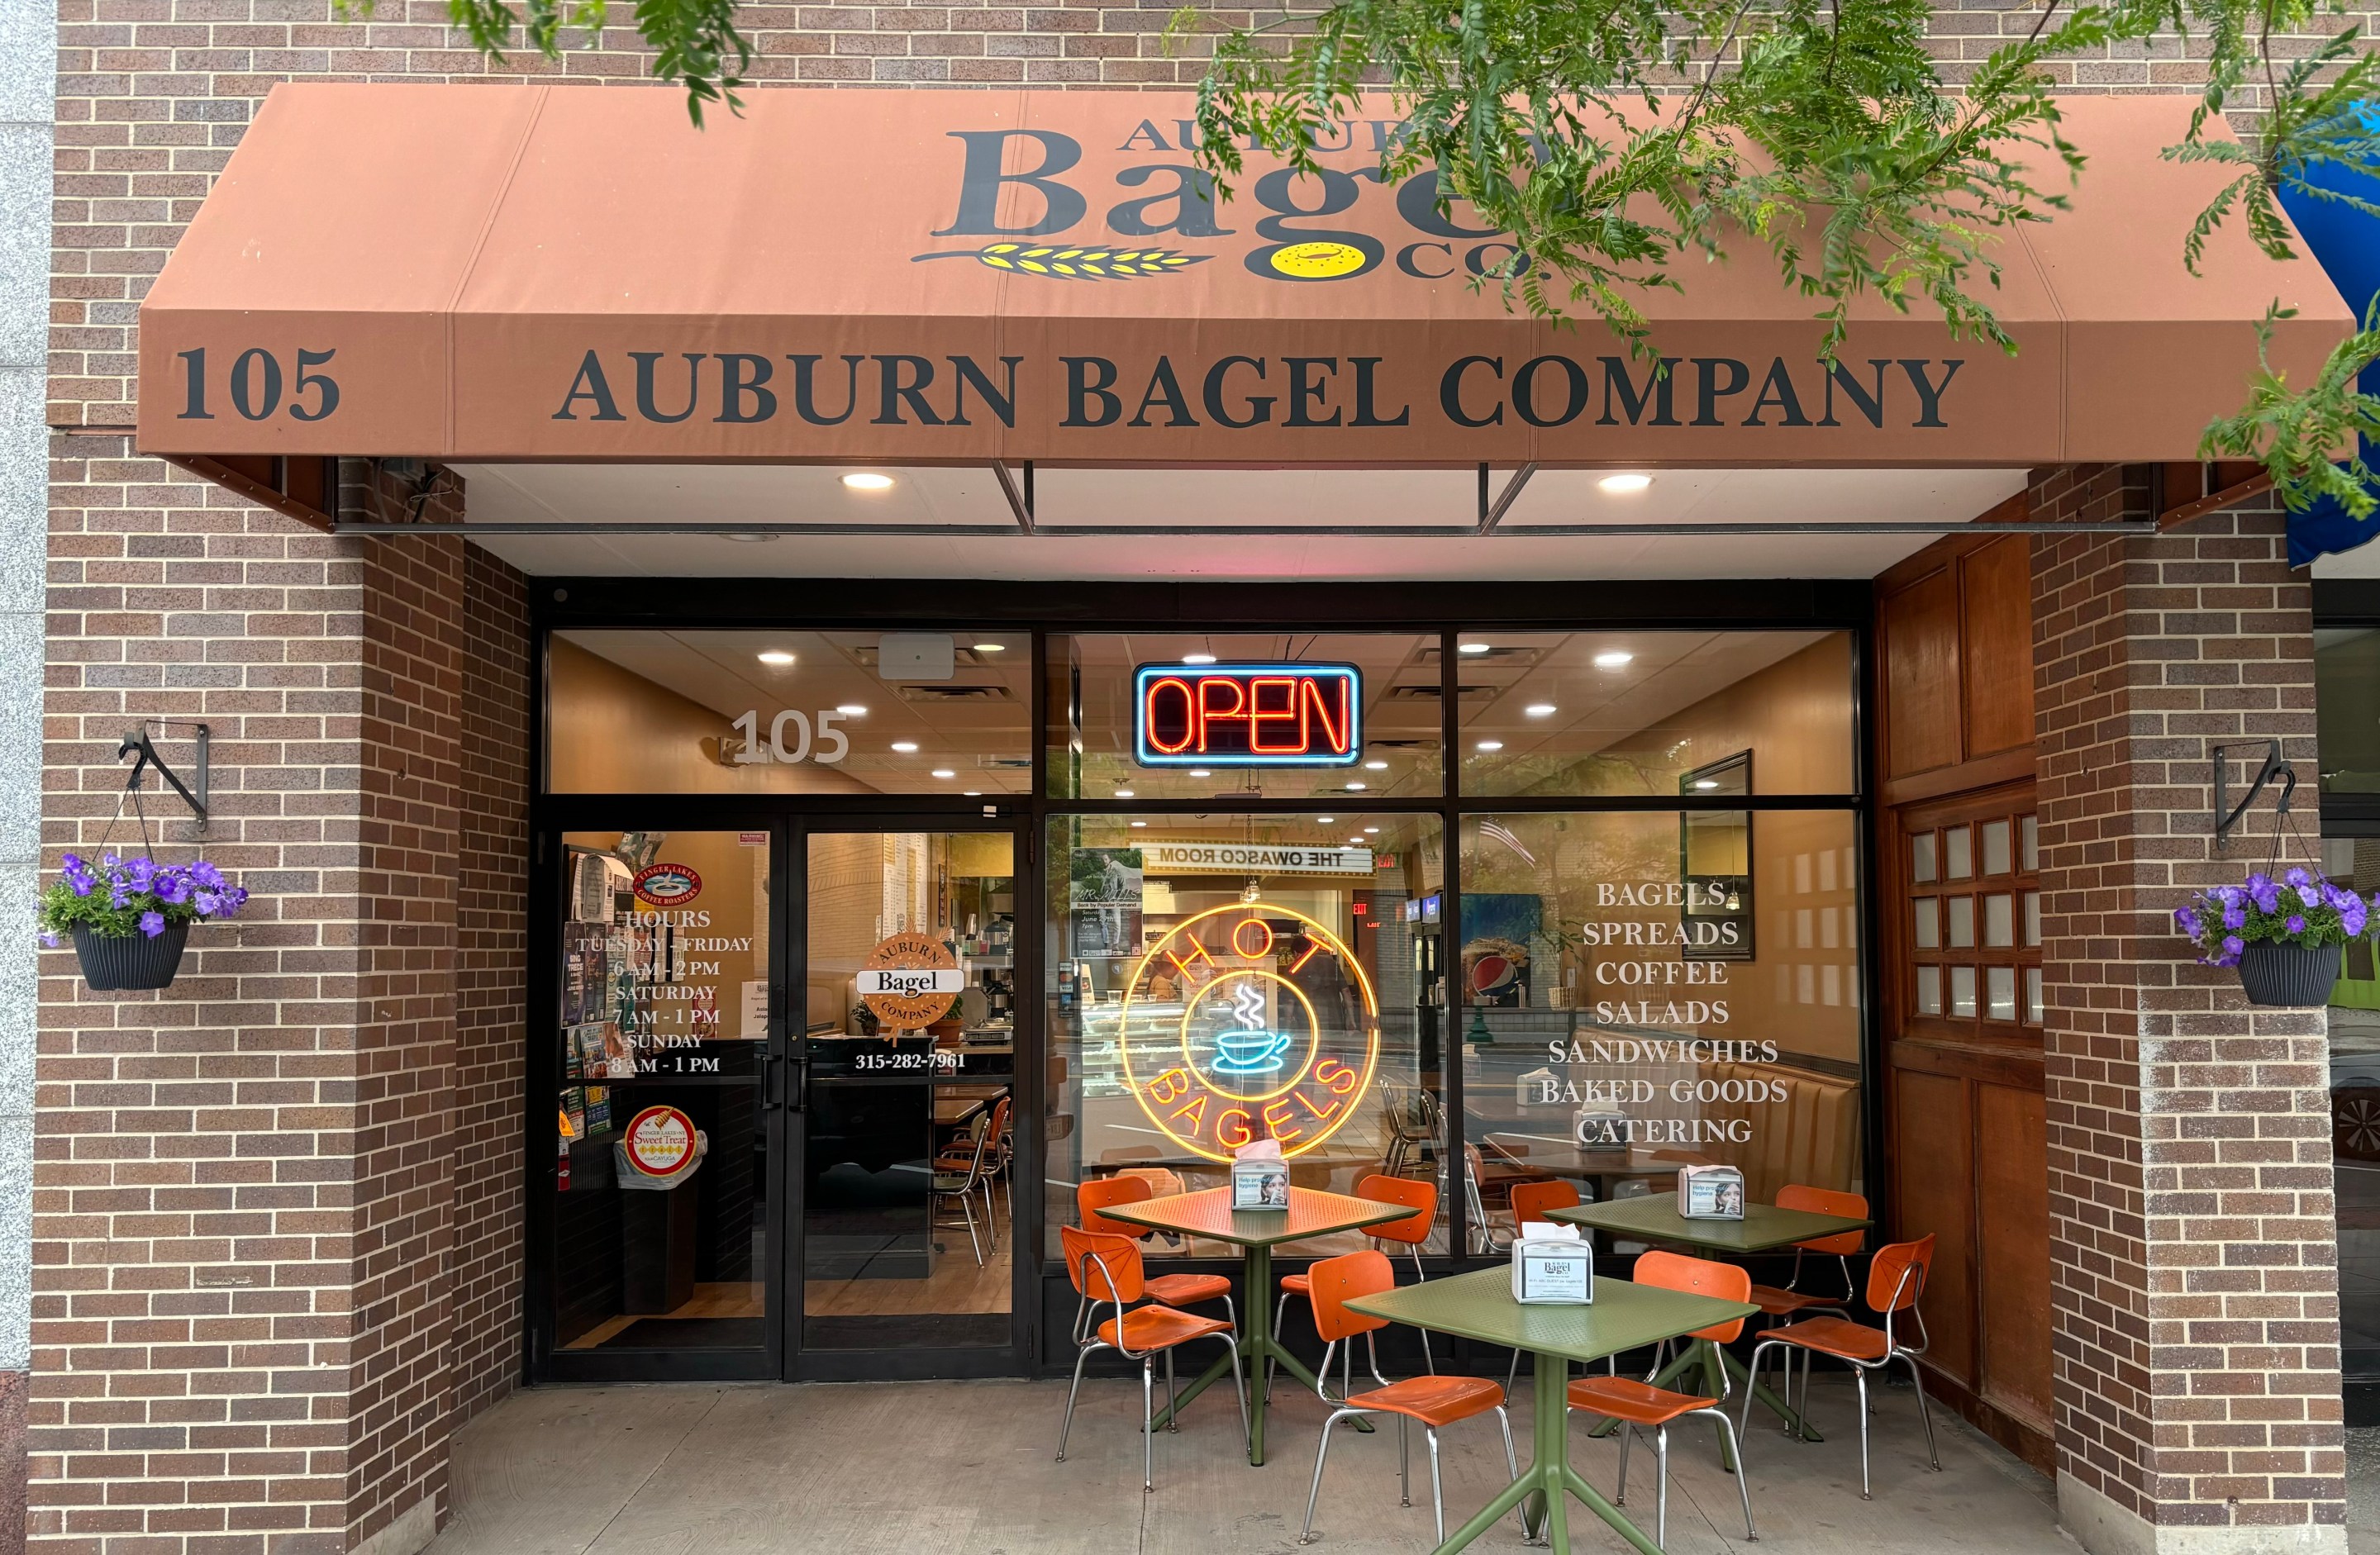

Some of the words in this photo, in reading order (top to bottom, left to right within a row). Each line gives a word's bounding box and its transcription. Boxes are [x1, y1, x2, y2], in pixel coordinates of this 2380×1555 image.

[930, 129, 1580, 283] Bage
[1396, 242, 1552, 279] CO.
[176, 346, 340, 422] 105
[551, 348, 1024, 428] AUBURN
[1059, 354, 1410, 430] BAGEL
[1440, 355, 1965, 429] COMPANY
[1146, 676, 1349, 754] OPEN
[731, 710, 850, 763] 105
[639, 866, 669, 880] FINGER
[673, 866, 697, 880] LAKES
[638, 889, 662, 904] COFFEE
[664, 889, 697, 904] ROASTERS
[1100, 888, 1140, 901] MILLS
[1596, 882, 1726, 907] BAGELS
[626, 911, 711, 928] HOURS
[1353, 903, 1367, 915] EXIT
[575, 938, 664, 951] TUESDAY
[683, 938, 753, 951] FRIDAY
[1583, 921, 1739, 946] SPREADS
[878, 941, 941, 965] AUBURN
[1166, 918, 1334, 984] HOT
[614, 961, 624, 976] 6
[628, 962, 659, 976] AM
[676, 961, 686, 976] 2
[689, 962, 721, 976] PM
[1595, 961, 1729, 986] COFFEE
[616, 986, 717, 1001] SATURDAY
[877, 972, 938, 998] Bagel
[612, 1009, 621, 1025] 7
[626, 1010, 658, 1024] AM
[675, 1009, 683, 1024] 1
[689, 1010, 721, 1024] PM
[881, 1001, 940, 1020] COMPANY
[1596, 1000, 1729, 1025] SALADS
[626, 1034, 704, 1049] SUNDAY
[1548, 1039, 1778, 1064] SANDWICHES
[611, 1057, 621, 1072] 8
[627, 1058, 658, 1072] AM
[675, 1057, 683, 1072] 1
[689, 1058, 720, 1072] PM
[855, 1053, 965, 1069] 315-282-7961
[1540, 1079, 1654, 1104] BAKED
[1669, 1079, 1788, 1104] GOODS
[1148, 1059, 1357, 1149] BAGELS
[635, 1132, 662, 1144] Sweet
[664, 1135, 687, 1144] Treat
[1577, 1119, 1753, 1144] CATERING
[1545, 1262, 1571, 1274] Bagel
